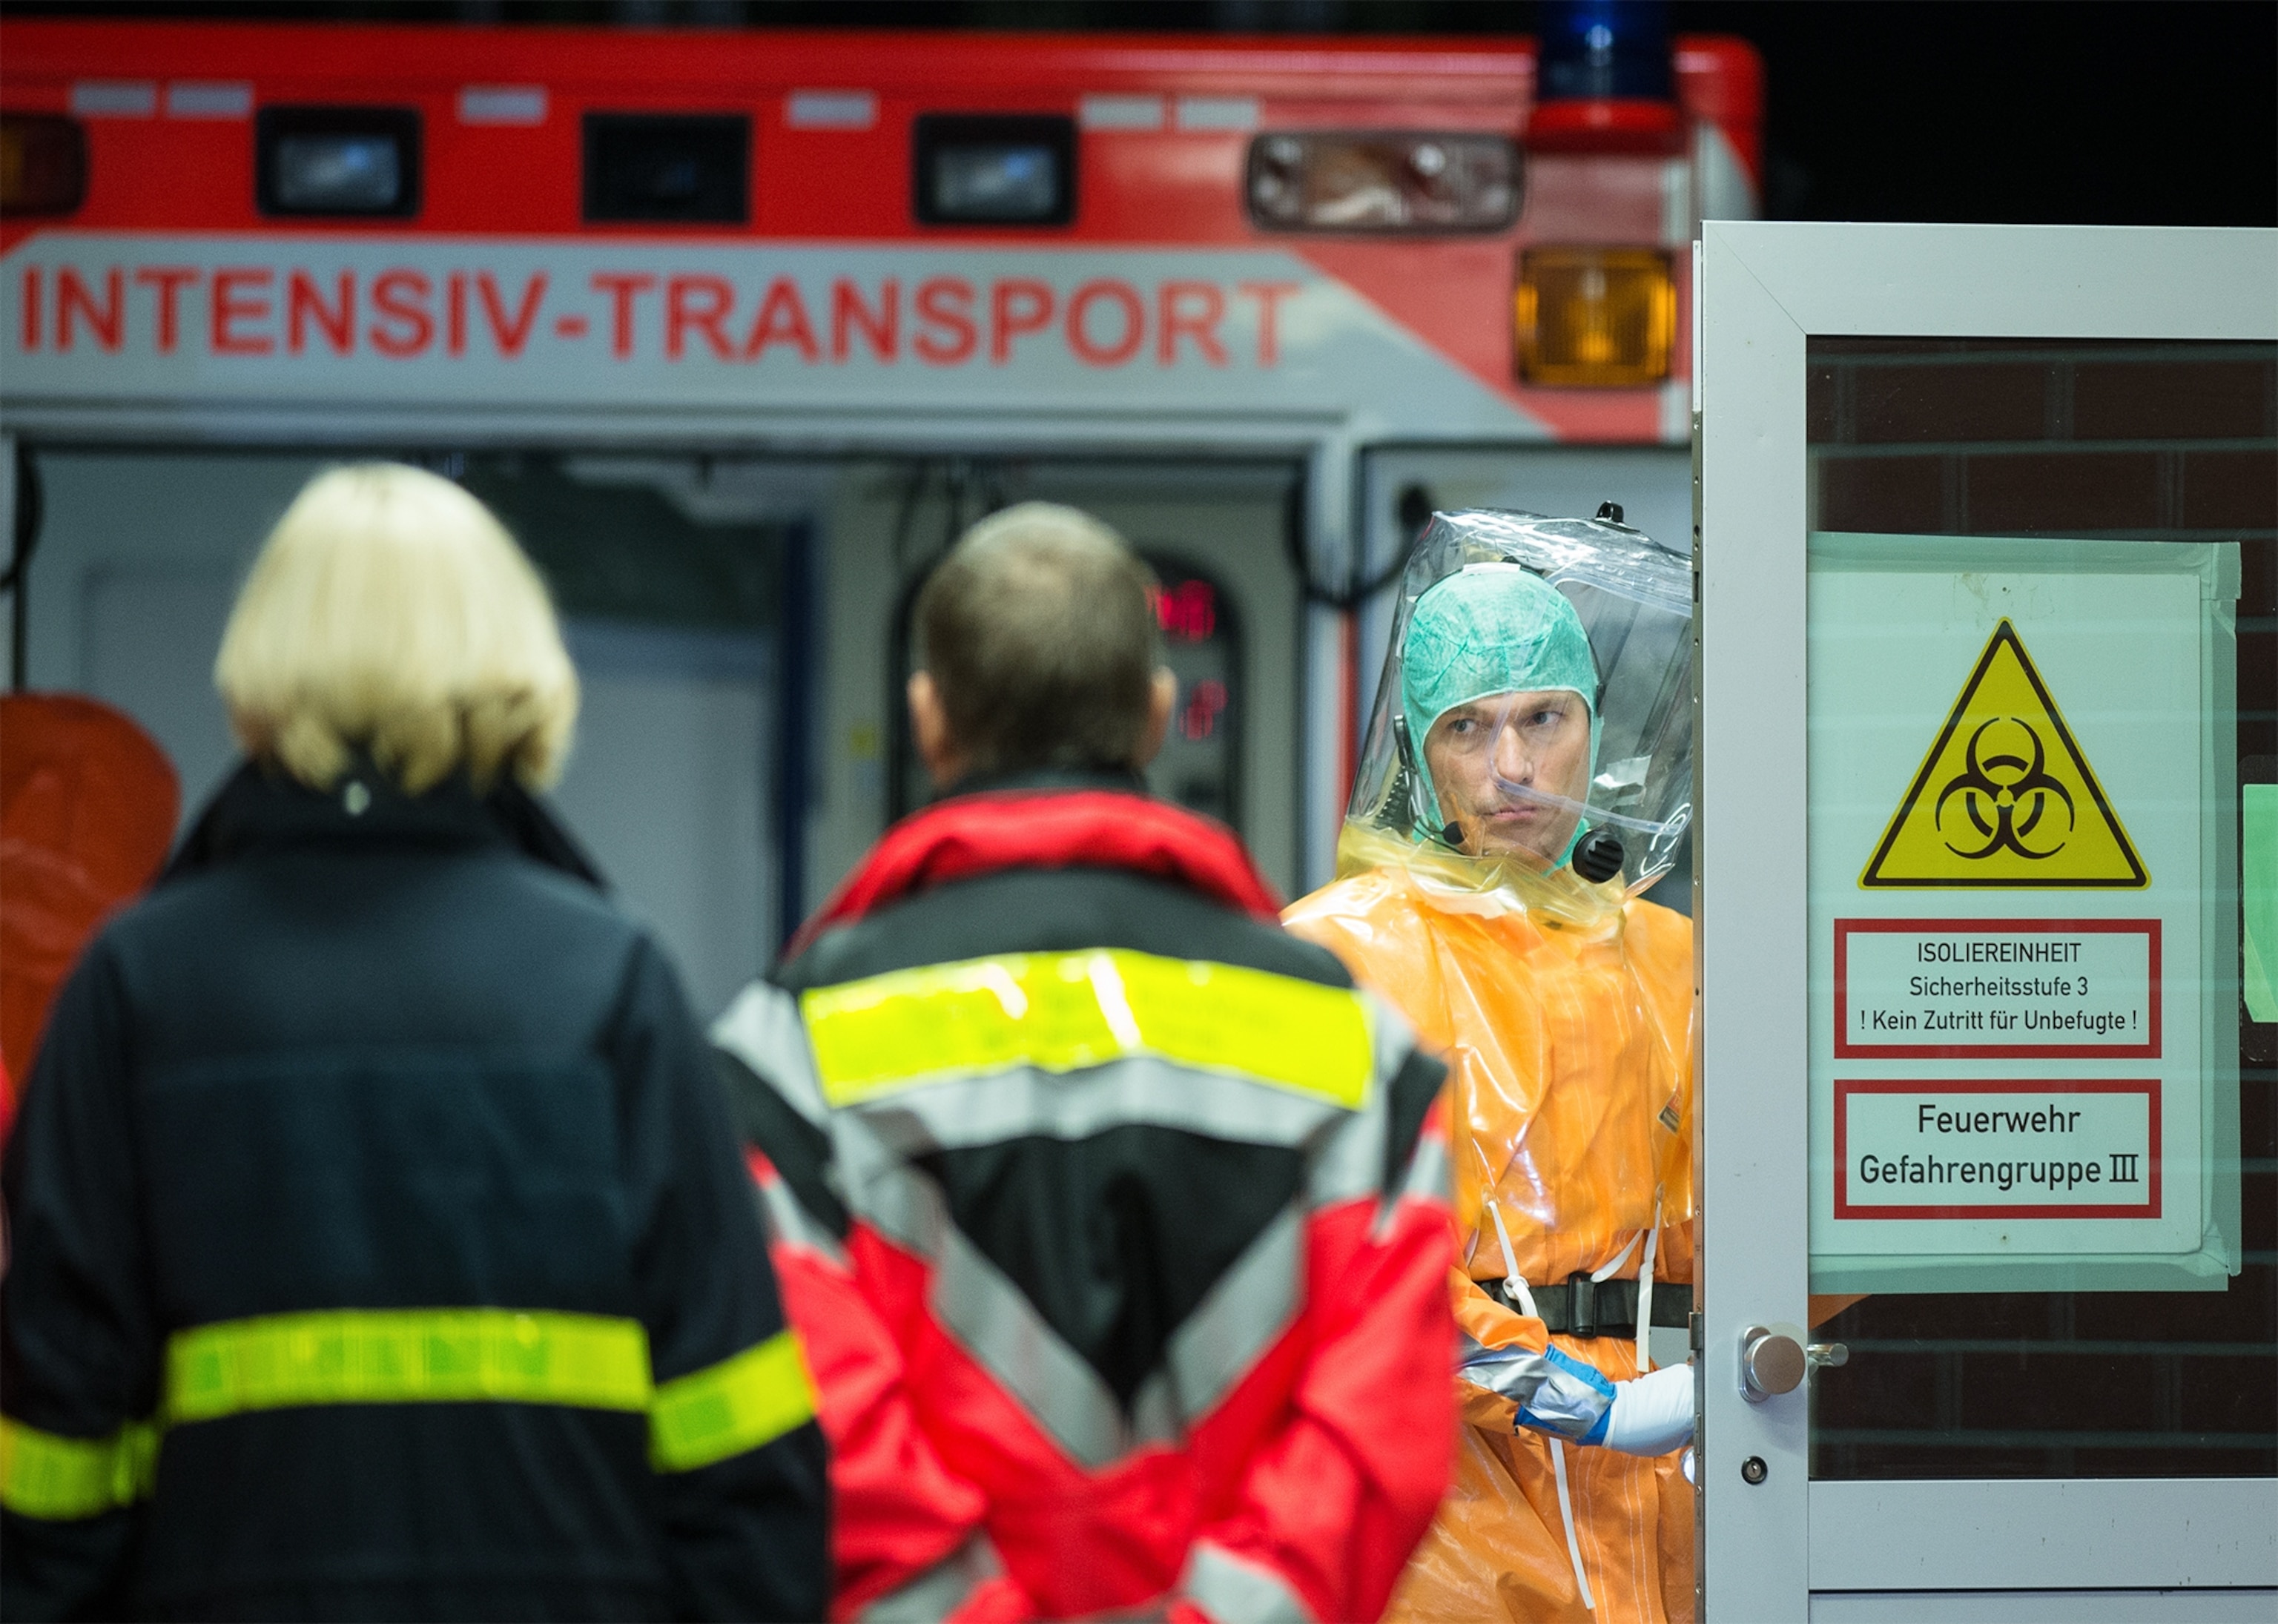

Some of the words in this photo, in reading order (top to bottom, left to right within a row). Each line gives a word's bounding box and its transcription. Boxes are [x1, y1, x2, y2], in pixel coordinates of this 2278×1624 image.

[21, 265, 1302, 368] INTENSIV-TRANSPORT
[1918, 943, 2081, 963] ISOLIEREINHEIT
[1909, 976, 2071, 996] Sicherheitsstufe
[2077, 976, 2089, 996] 3
[1873, 1010, 1917, 1030] Kein
[1924, 1010, 1984, 1030] Zutritt
[1990, 1009, 2018, 1030] für
[2024, 1009, 2125, 1035] Unbefugte
[1918, 1103, 2081, 1133] Feuerwehr
[1860, 1154, 2102, 1192] Gefahrengruppe
[2109, 1153, 2139, 1183] III
